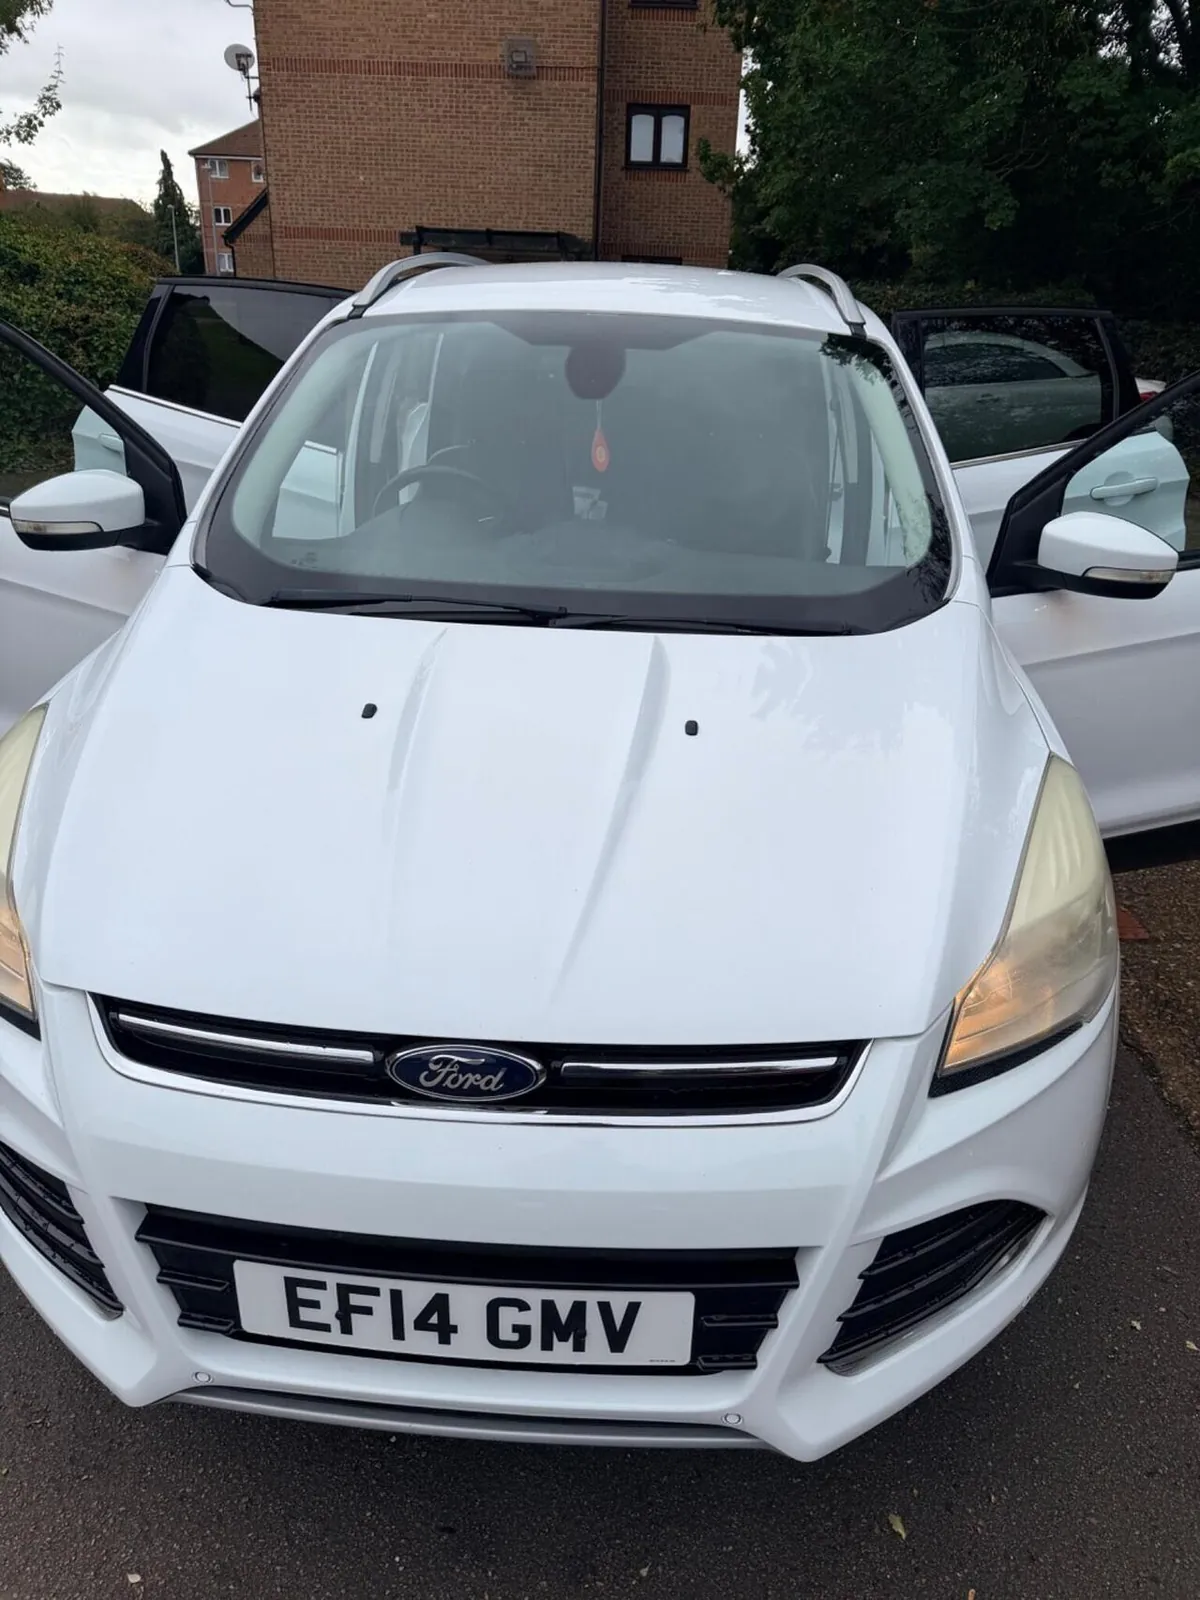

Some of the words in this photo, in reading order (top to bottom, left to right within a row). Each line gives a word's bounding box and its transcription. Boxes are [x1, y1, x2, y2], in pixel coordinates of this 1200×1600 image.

[419, 1054, 504, 1091] Ford
[283, 1275, 459, 1346] EF14
[485, 1296, 643, 1354] GMV
